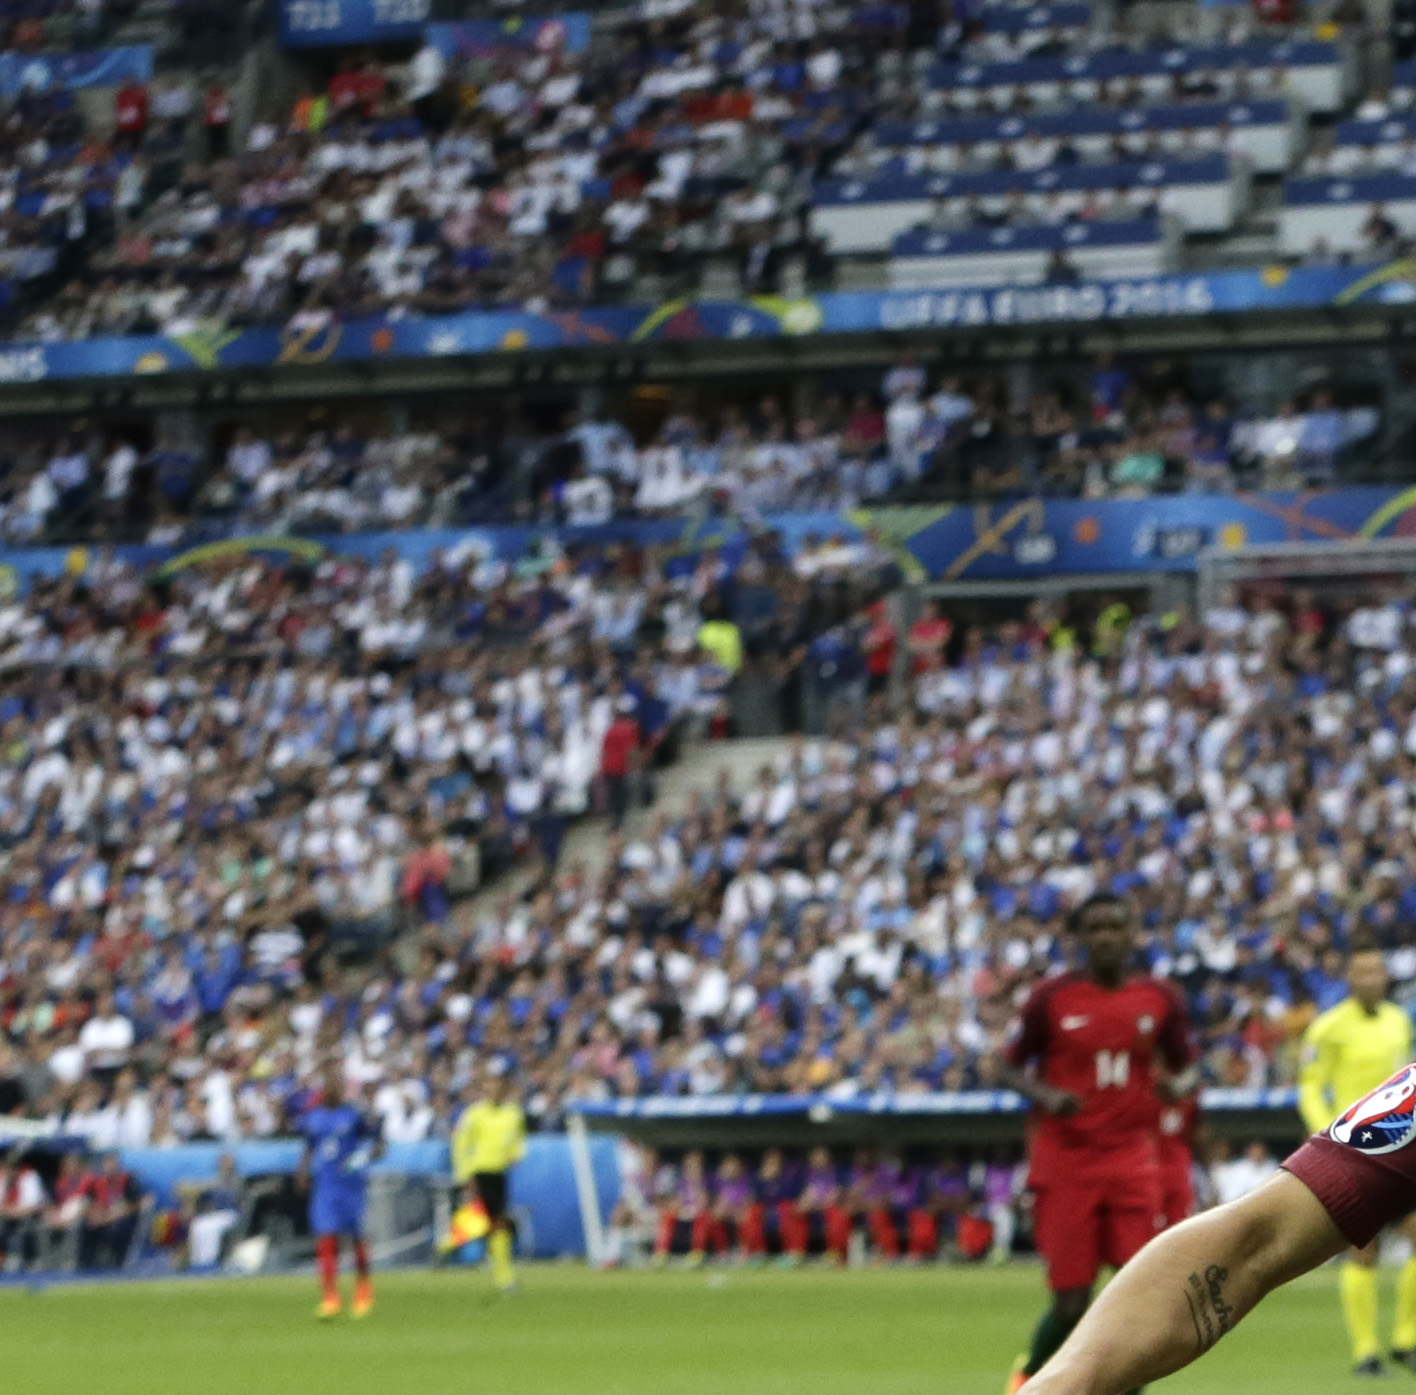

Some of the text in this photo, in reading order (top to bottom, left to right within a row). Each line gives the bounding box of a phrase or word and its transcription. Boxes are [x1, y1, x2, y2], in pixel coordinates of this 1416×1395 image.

[880, 278, 1214, 332] UEFA EURO 2016
[1095, 1048, 1130, 1090] 14
